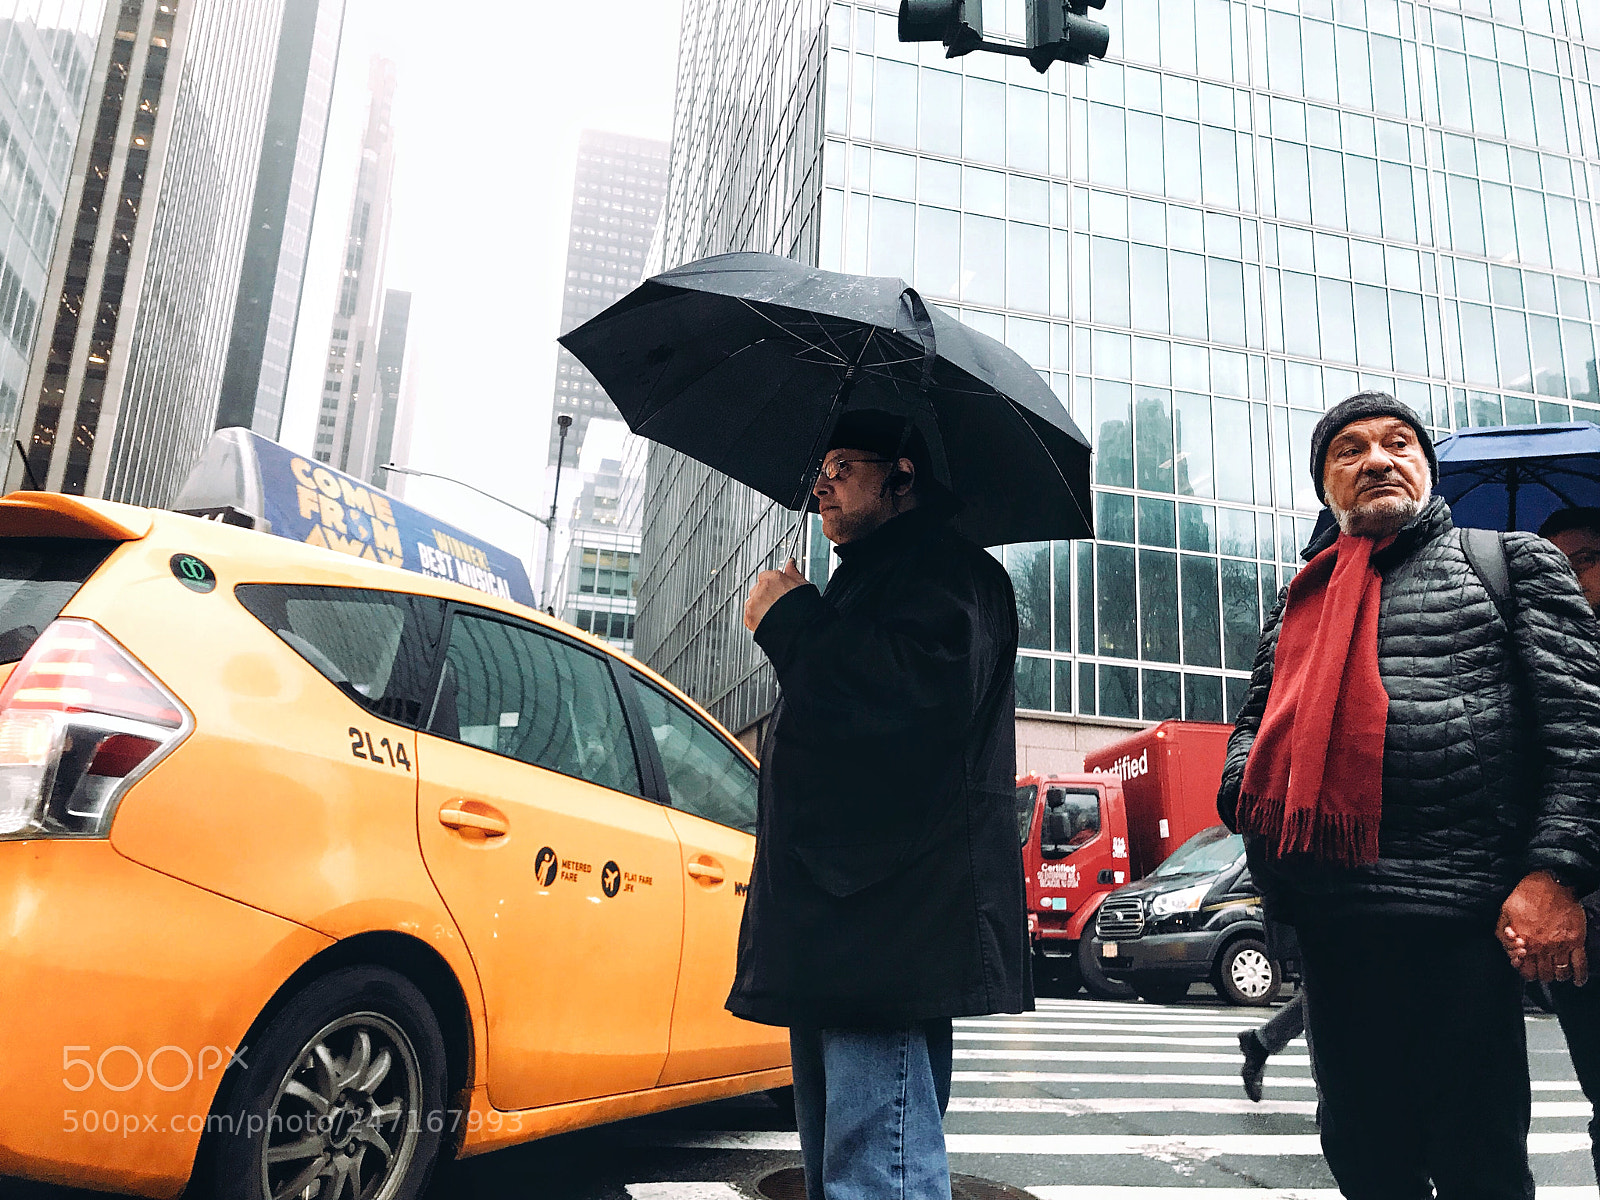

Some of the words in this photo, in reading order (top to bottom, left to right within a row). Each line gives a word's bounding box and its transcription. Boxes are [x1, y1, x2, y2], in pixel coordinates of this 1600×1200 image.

[290, 457, 396, 527] COME
[296, 484, 403, 558] FROM
[417, 541, 454, 580] BEST
[454, 558, 514, 603] MUSICAL
[348, 726, 411, 772] 2L14
[561, 859, 592, 873] METERED
[1041, 863, 1076, 873] Certified
[560, 871, 578, 882] FARE
[624, 872, 637, 882] FLAT
[638, 875, 653, 886] FARE
[623, 883, 634, 893] JFK
